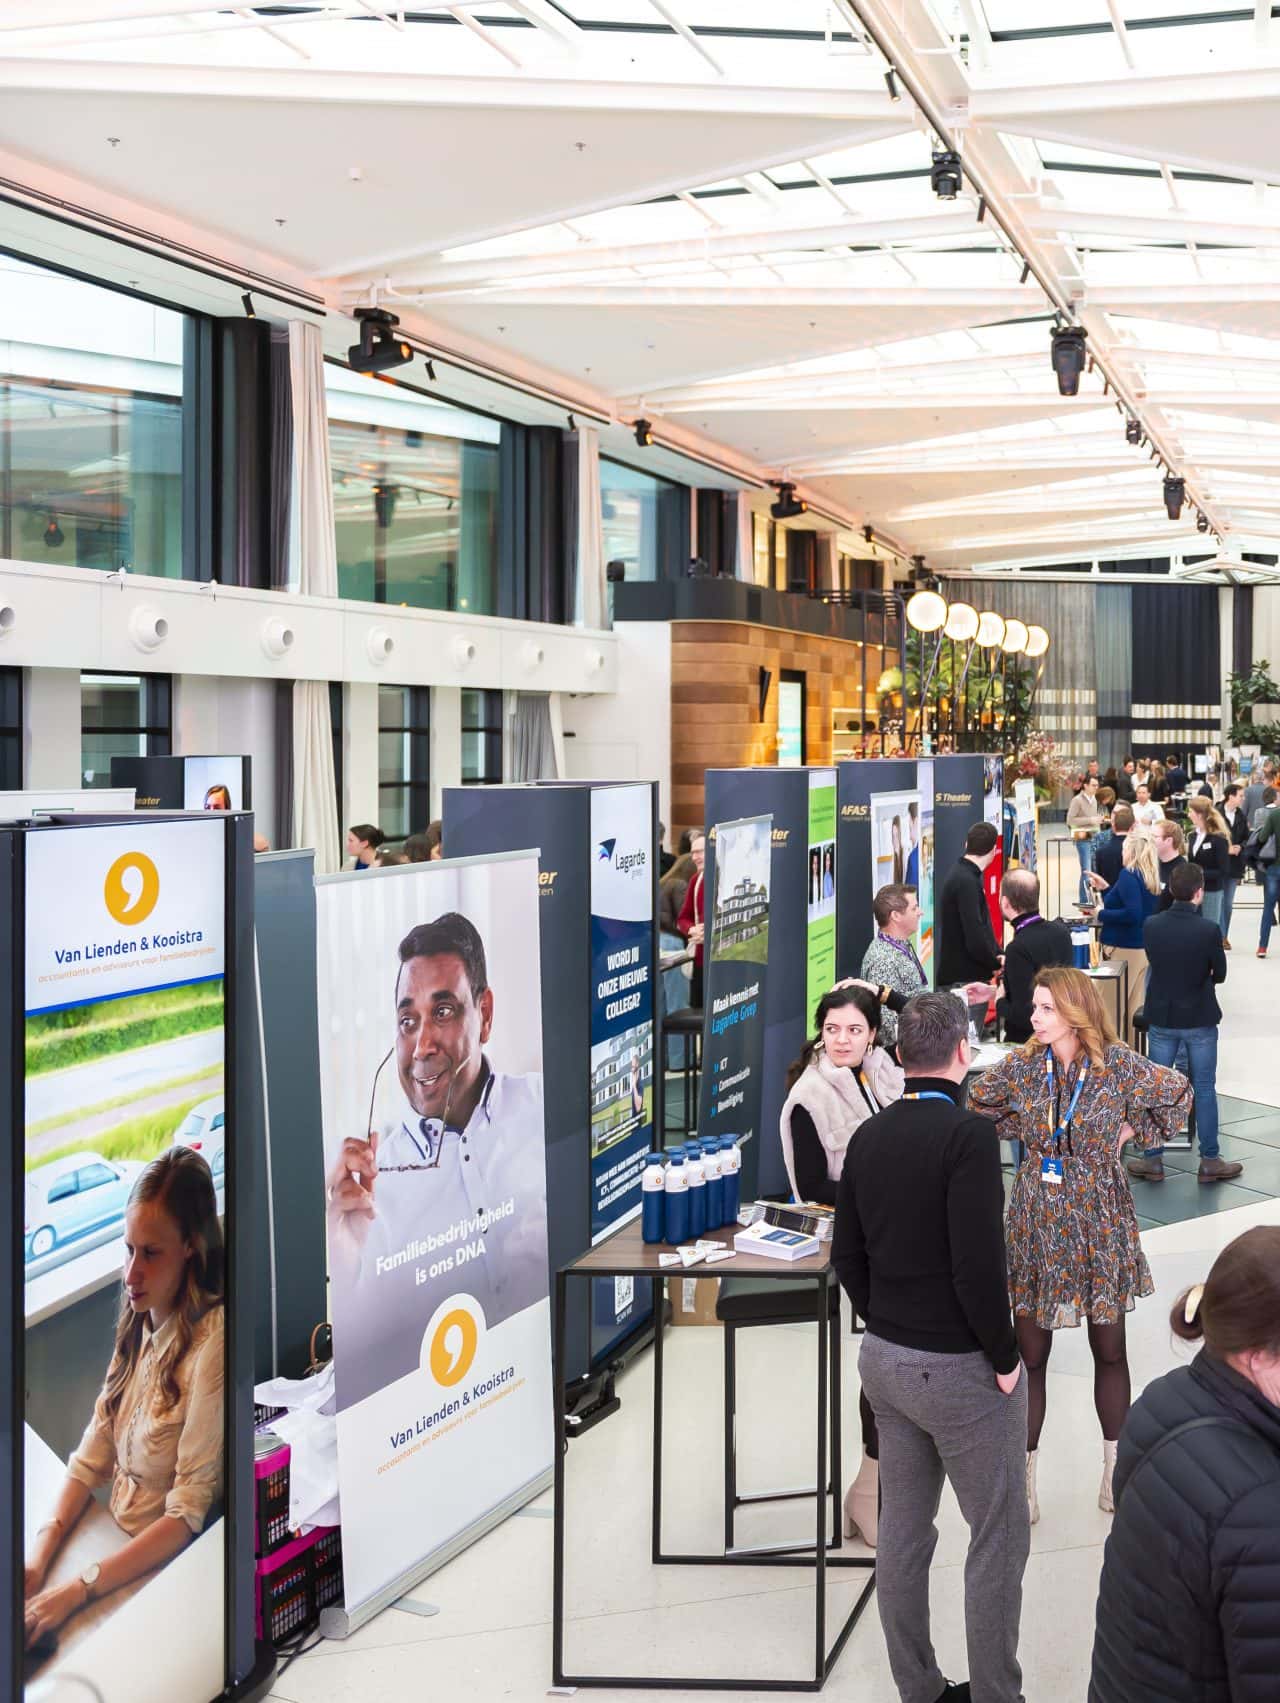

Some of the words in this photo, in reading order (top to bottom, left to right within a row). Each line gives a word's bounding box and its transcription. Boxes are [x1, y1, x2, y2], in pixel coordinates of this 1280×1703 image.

[840, 804, 868, 816] AFAS
[615, 849, 646, 873] Lagarde
[55, 949, 81, 964] Van
[85, 939, 137, 960] Lienden
[140, 936, 149, 950] &
[153, 930, 203, 949] Kooistra
[607, 951, 631, 971] WORD
[91, 964, 101, 974] en
[597, 979, 619, 1000] ONZE
[619, 966, 648, 992] NIEUWE
[605, 992, 641, 1021] COLLEGA?
[712, 996, 729, 1015] Maak
[711, 1010, 739, 1035] Lagarde
[376, 1198, 515, 1276] Familiebedrijvigheid
[415, 1267, 427, 1286] is
[429, 1255, 454, 1281] ons
[456, 1238, 487, 1267] DNA
[390, 1426, 413, 1450] Van
[416, 1397, 460, 1435] Lienden
[462, 1390, 471, 1407] &
[473, 1364, 515, 1398] Kooistra
[377, 1443, 421, 1475] accountants
[422, 1438, 431, 1449] en
